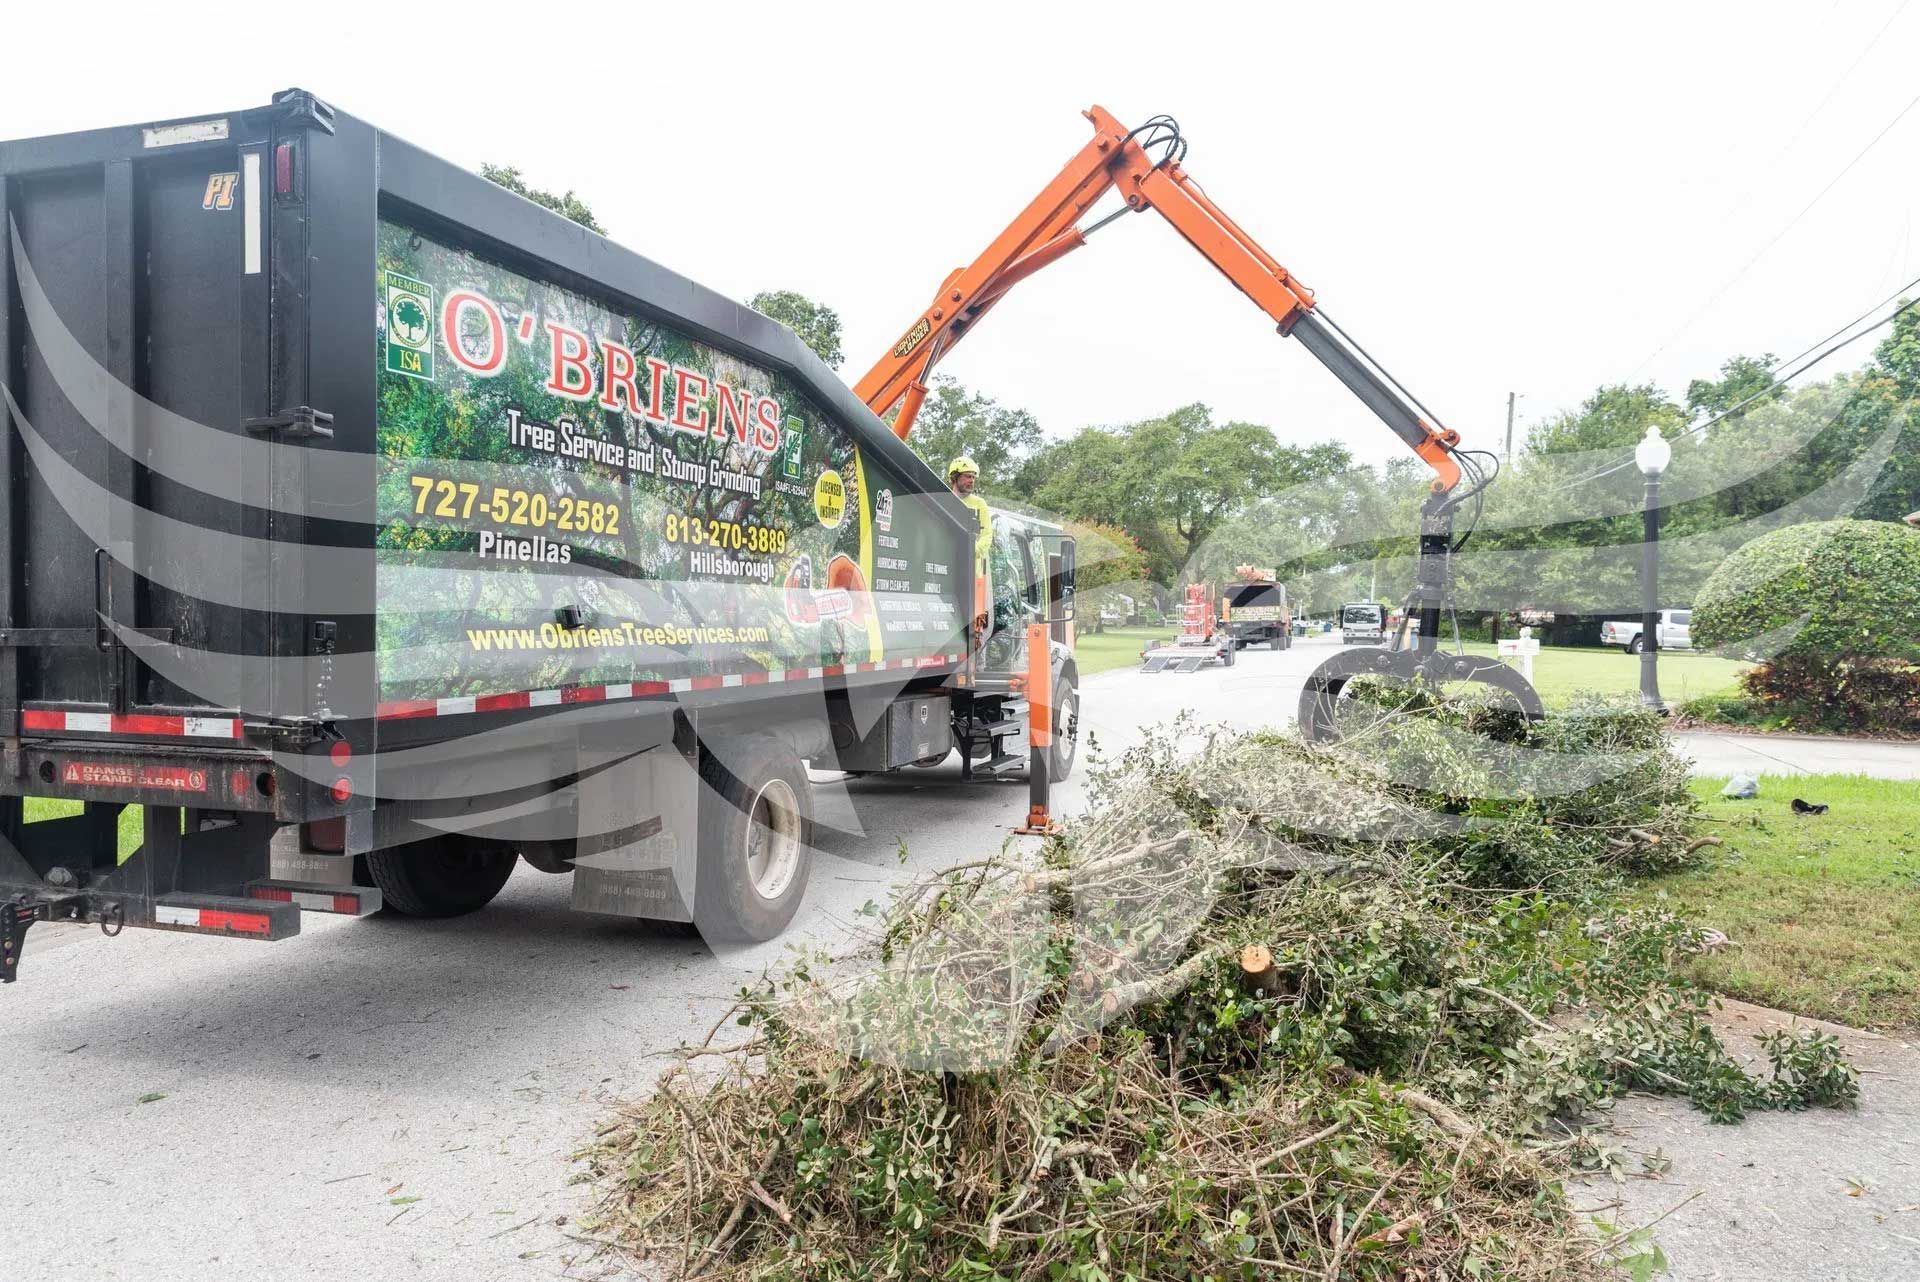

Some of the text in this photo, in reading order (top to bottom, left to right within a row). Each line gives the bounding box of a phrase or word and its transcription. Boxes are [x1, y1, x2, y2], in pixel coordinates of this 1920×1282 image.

[203, 172, 239, 210] PI
[388, 275, 430, 294] MEMBER
[400, 349, 422, 372] ISA
[443, 291, 782, 453] O'BRIENS
[507, 409, 761, 499] Tree Service and Stump Grinding
[411, 475, 619, 535] 727-520-2582
[479, 530, 571, 564] Pinellas
[666, 514, 786, 555] 813-270-3889
[690, 551, 775, 583] Hillsborough
[467, 622, 769, 651] www.ObriensTreeServices.com
[83, 773, 185, 787] STAND CLEAR
